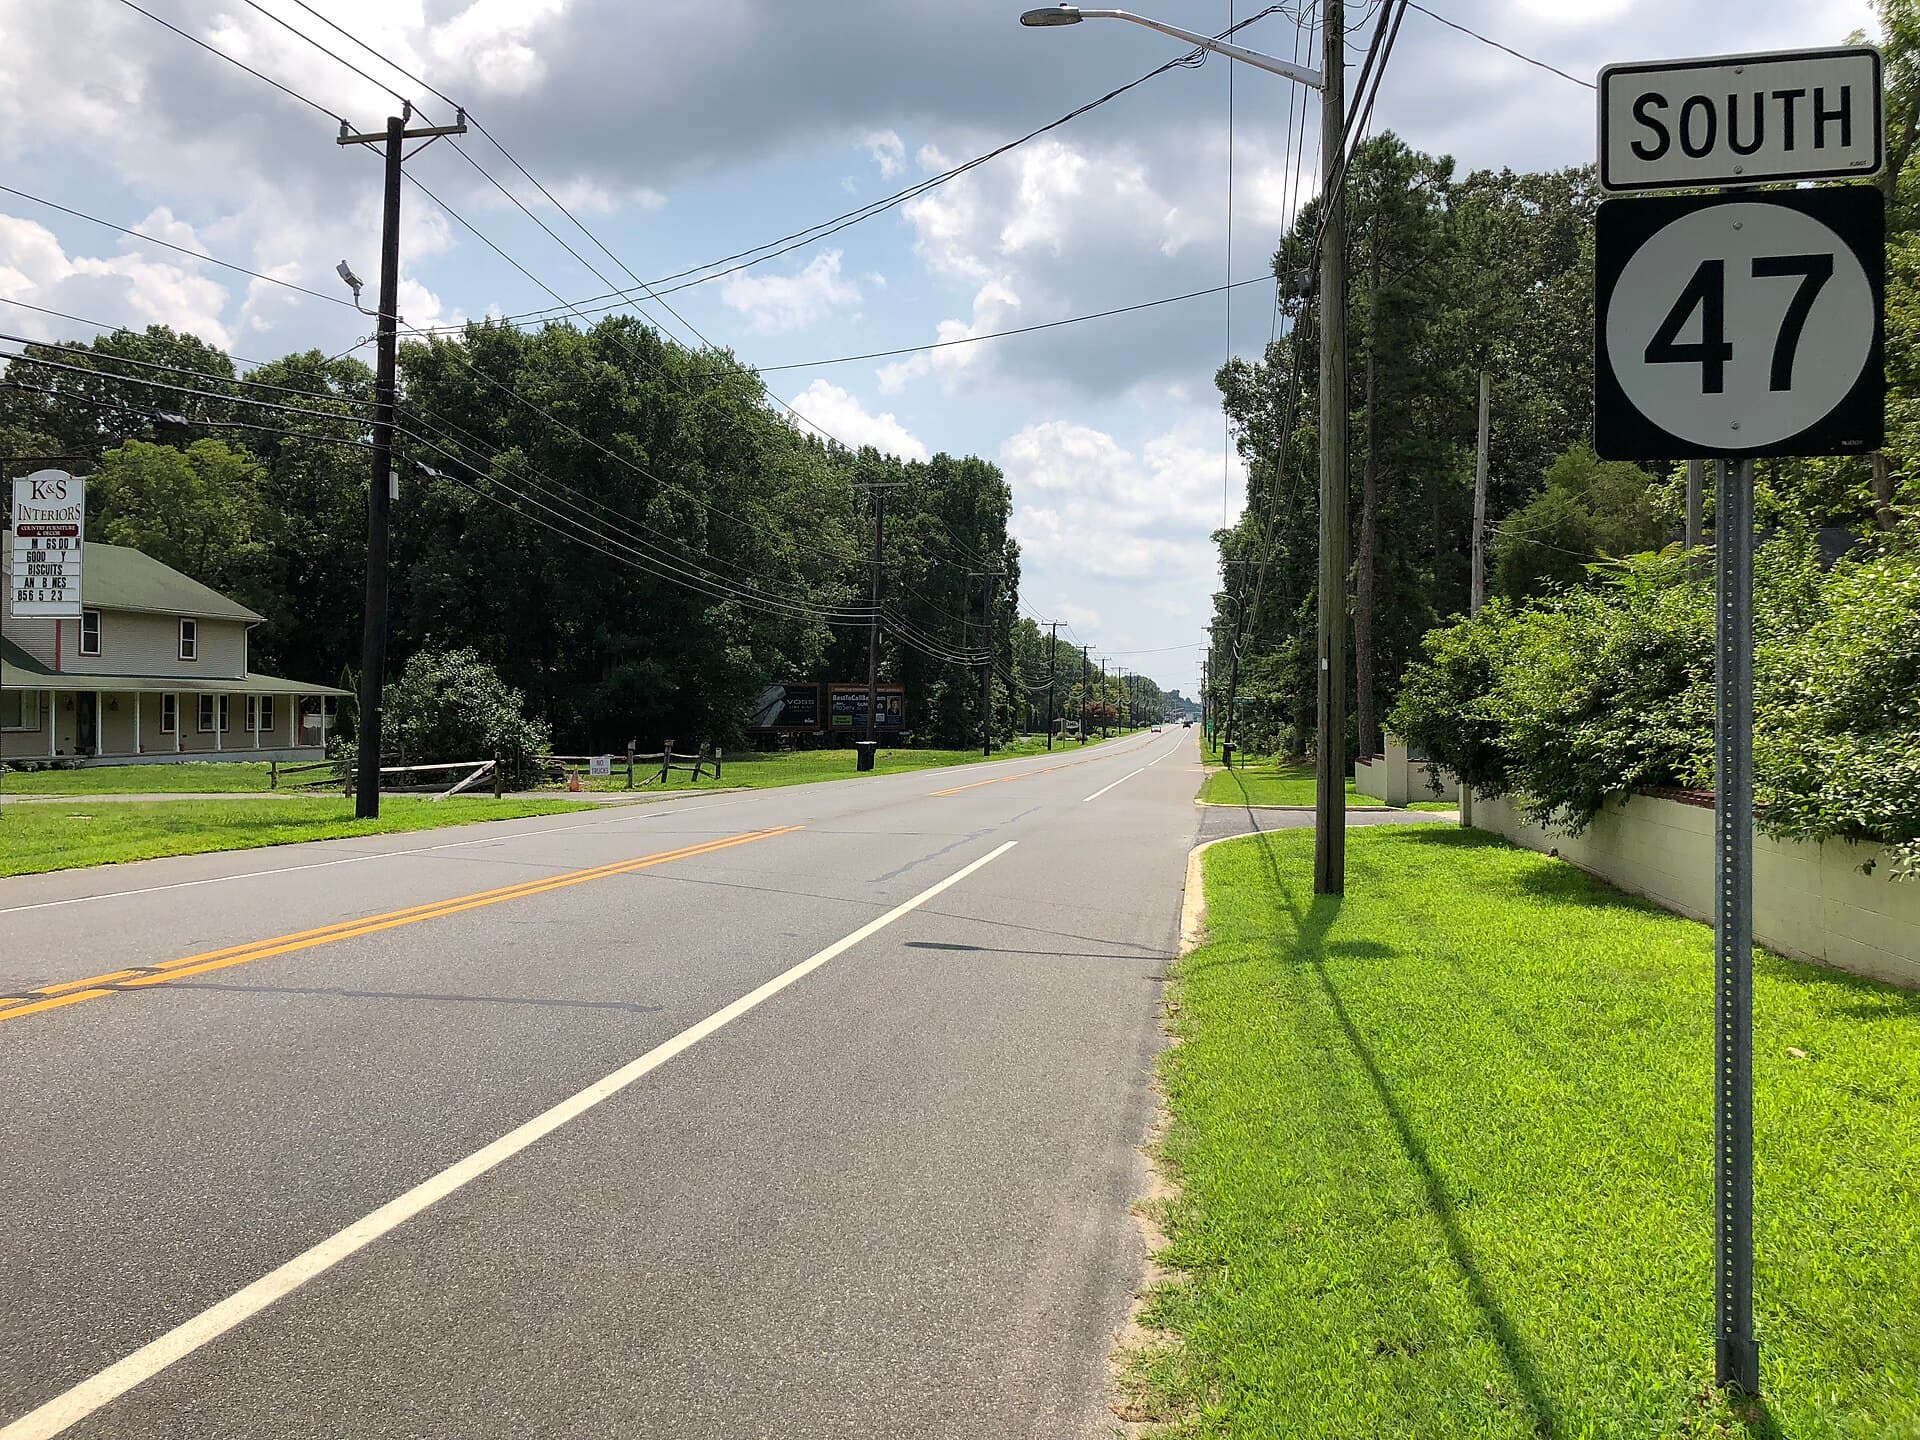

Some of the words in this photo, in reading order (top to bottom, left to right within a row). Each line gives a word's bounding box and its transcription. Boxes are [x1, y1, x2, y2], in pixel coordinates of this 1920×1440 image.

[1630, 85, 1852, 161] SOUTH
[1643, 252, 1835, 395] 47
[31, 480, 67, 500] K&S
[17, 503, 81, 521] INTERIORS
[26, 551, 46, 562] GOOD
[61, 551, 67, 562] Y
[28, 564, 63, 575] BISCUITS
[24, 576, 35, 588] AN
[17, 590, 34, 601] 856
